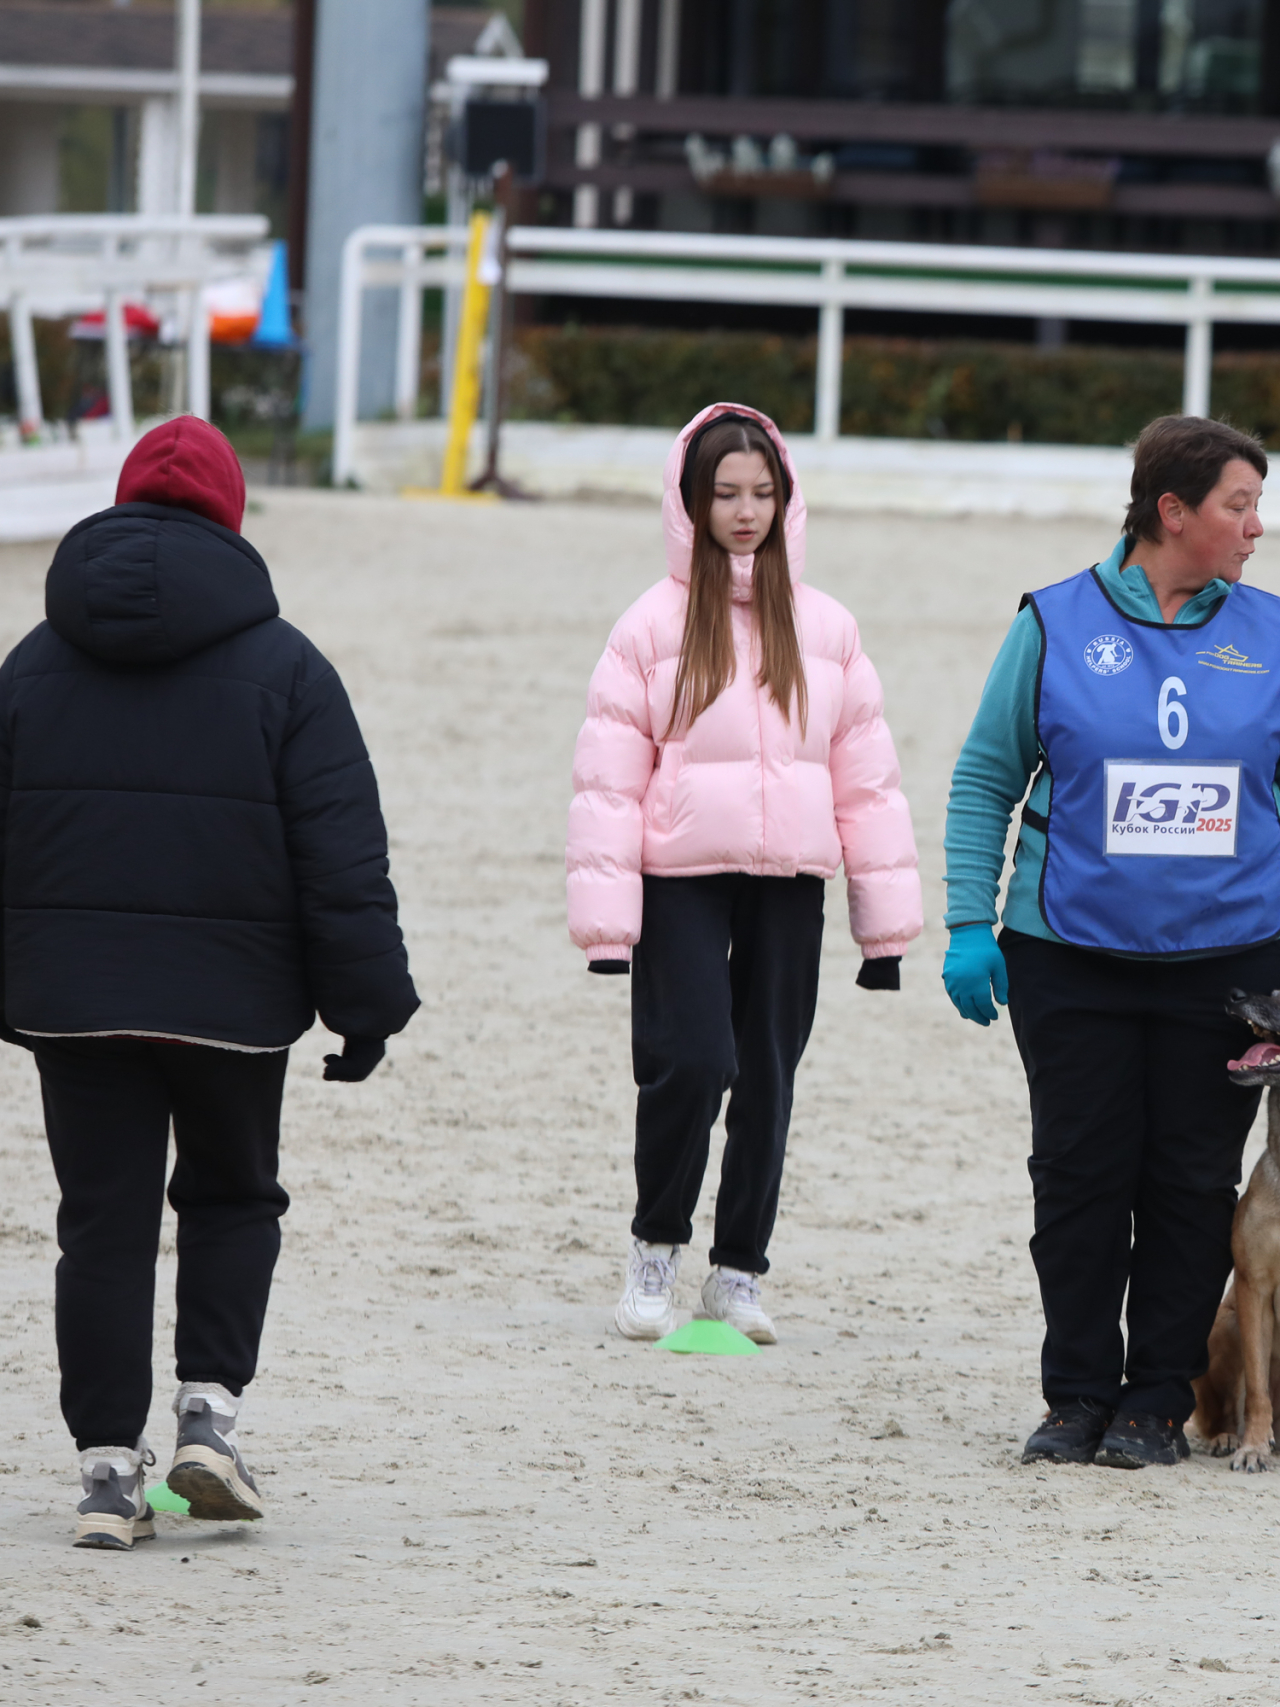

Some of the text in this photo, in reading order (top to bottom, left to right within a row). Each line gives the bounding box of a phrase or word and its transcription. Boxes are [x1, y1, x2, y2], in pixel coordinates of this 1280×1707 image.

[1092, 636, 1125, 647] RUSSIA
[1222, 659, 1263, 668] TRAINERS
[1157, 676, 1189, 750] 6
[1112, 782, 1231, 823] IGP
[1112, 818, 1232, 835] Кубок России 2025
